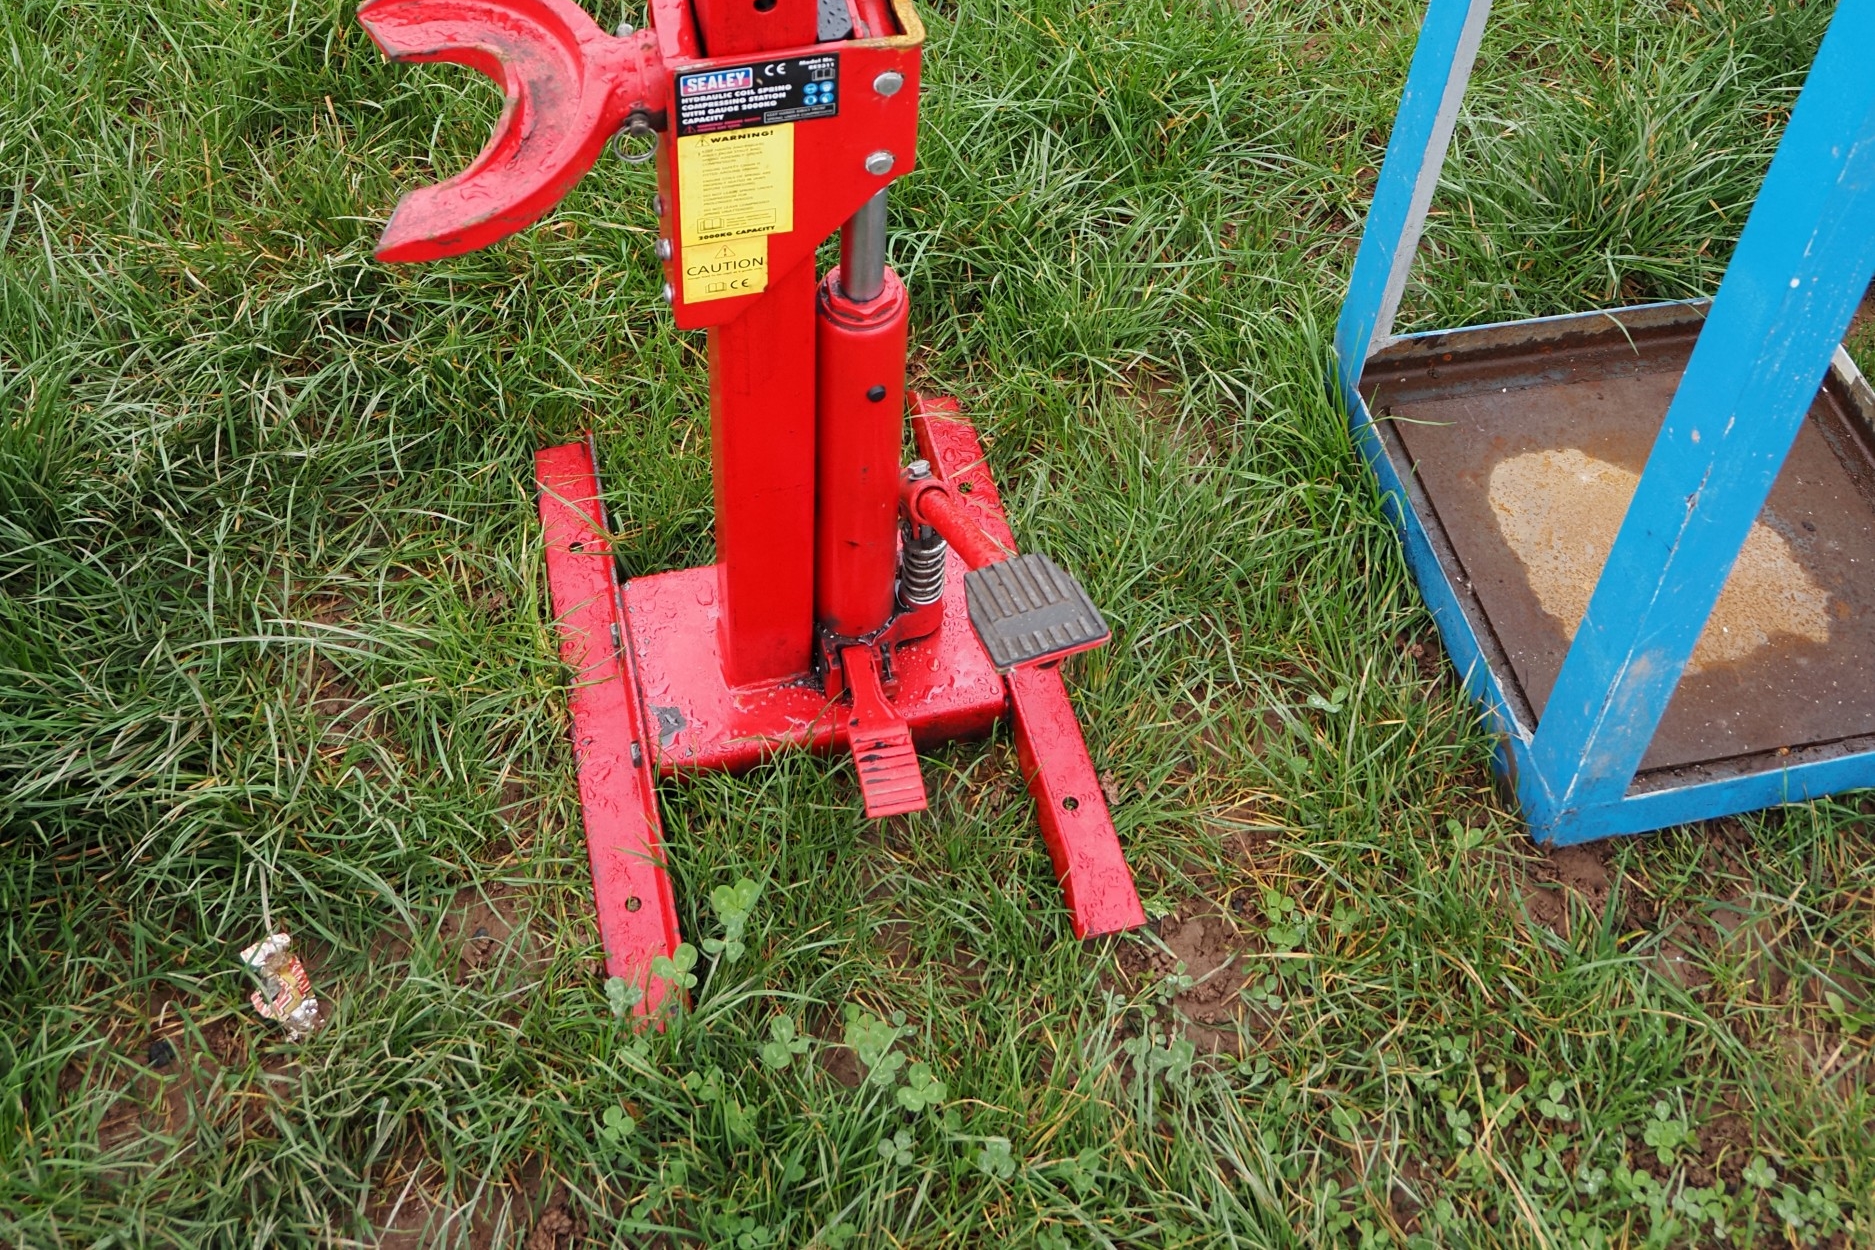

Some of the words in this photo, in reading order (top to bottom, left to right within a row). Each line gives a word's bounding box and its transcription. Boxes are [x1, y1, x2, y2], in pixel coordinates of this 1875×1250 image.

[687, 71, 746, 93] SEALEY
[681, 92, 732, 104] HYDRAULIC
[734, 89, 756, 98] COIL
[757, 84, 792, 95] SPRING
[681, 97, 747, 111] COMPRESSING
[748, 92, 786, 103] STATION
[681, 109, 705, 118] WITH
[707, 104, 740, 115] GAUGE
[741, 100, 777, 111] 2000KG
[682, 114, 724, 125] CAPACITY
[710, 130, 774, 144] WARNING!
[698, 231, 732, 241] 2000KG
[735, 225, 775, 236] CAPACITY
[686, 256, 764, 277] CAUTION
